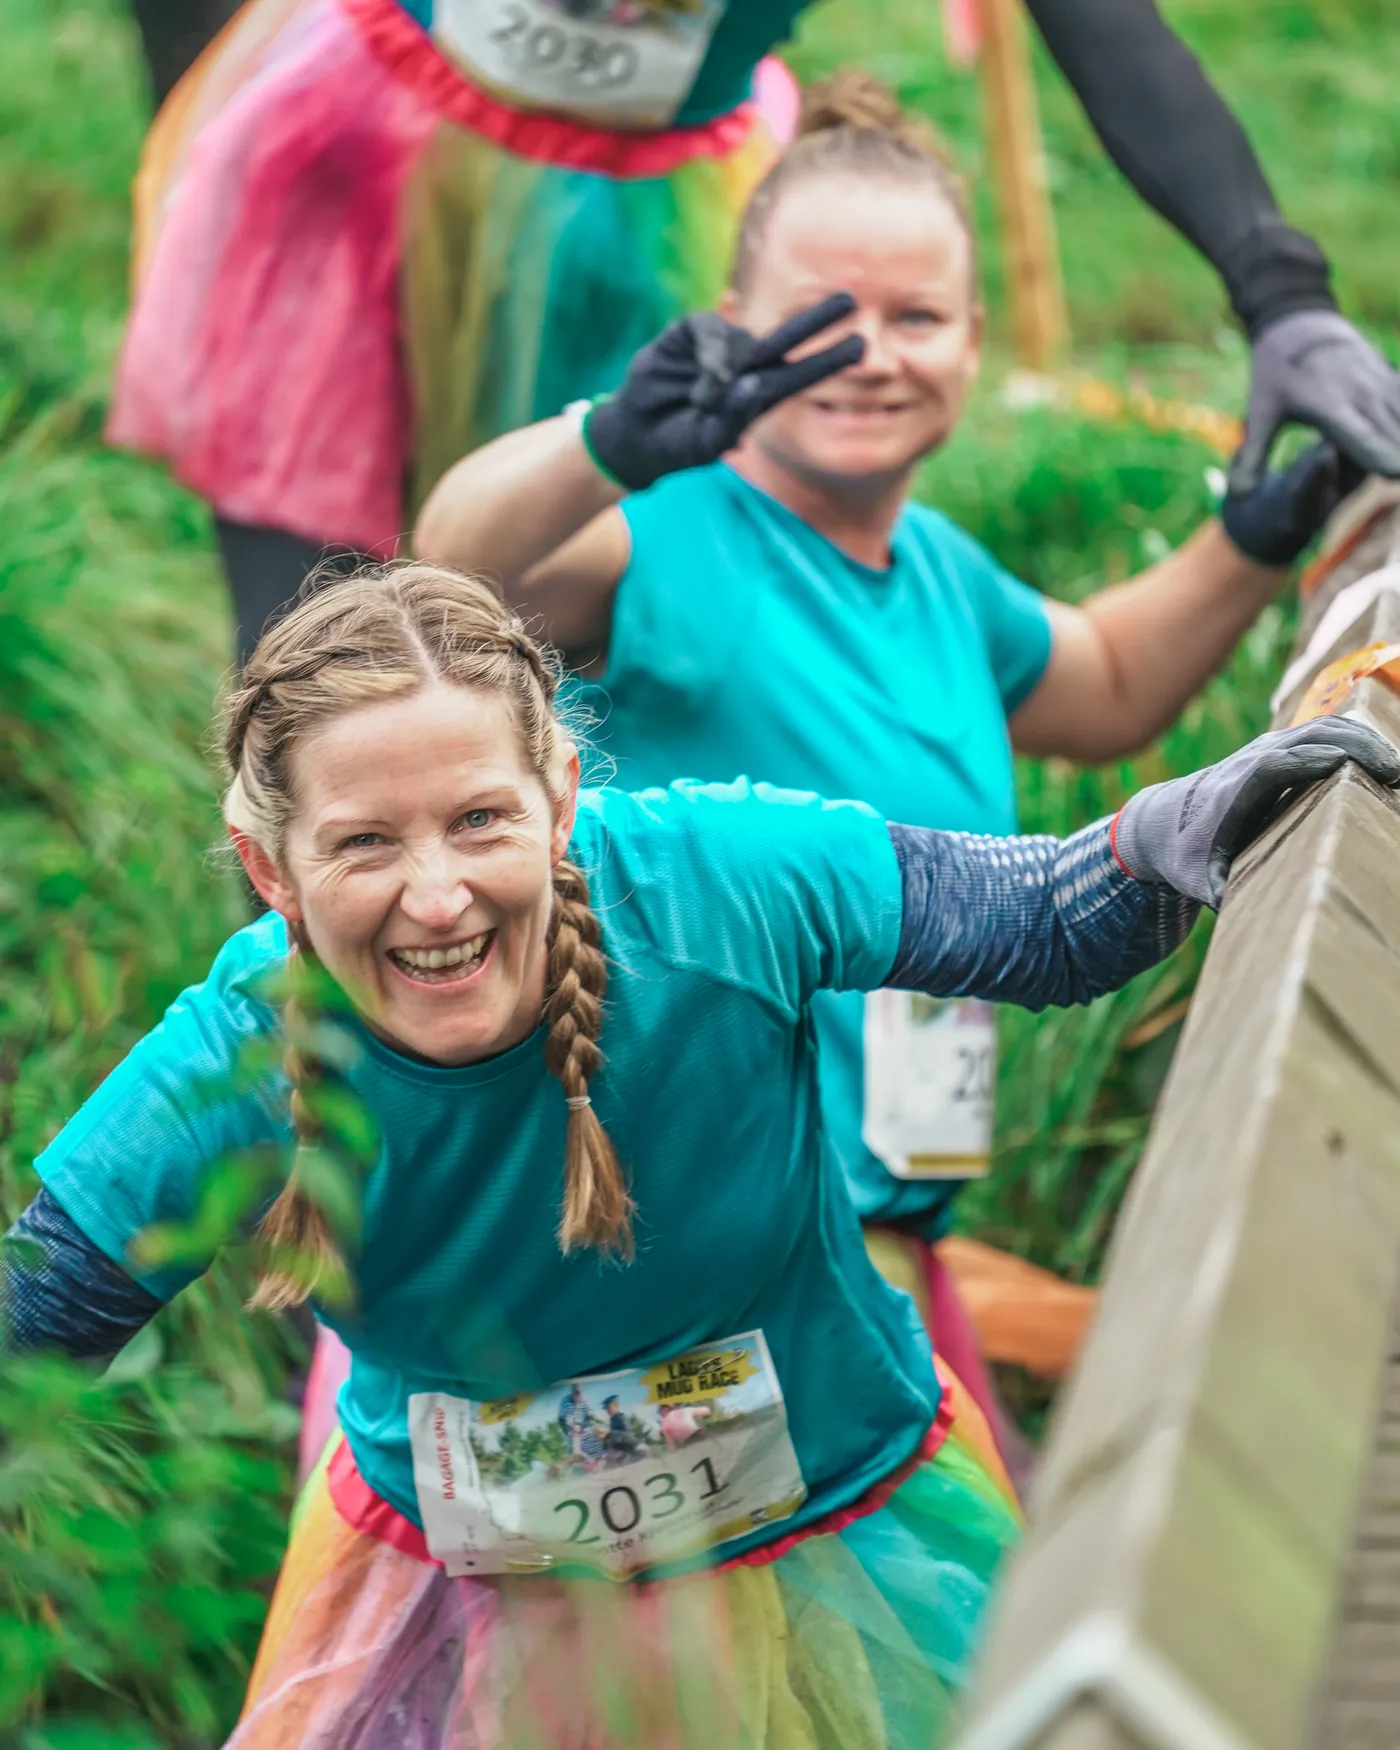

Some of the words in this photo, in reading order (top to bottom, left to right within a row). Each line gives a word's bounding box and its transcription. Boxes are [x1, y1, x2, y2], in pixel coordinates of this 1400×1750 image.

[487, 3, 641, 92] 2030
[698, 1370, 739, 1392] RACE
[553, 1456, 731, 1544] 2031
